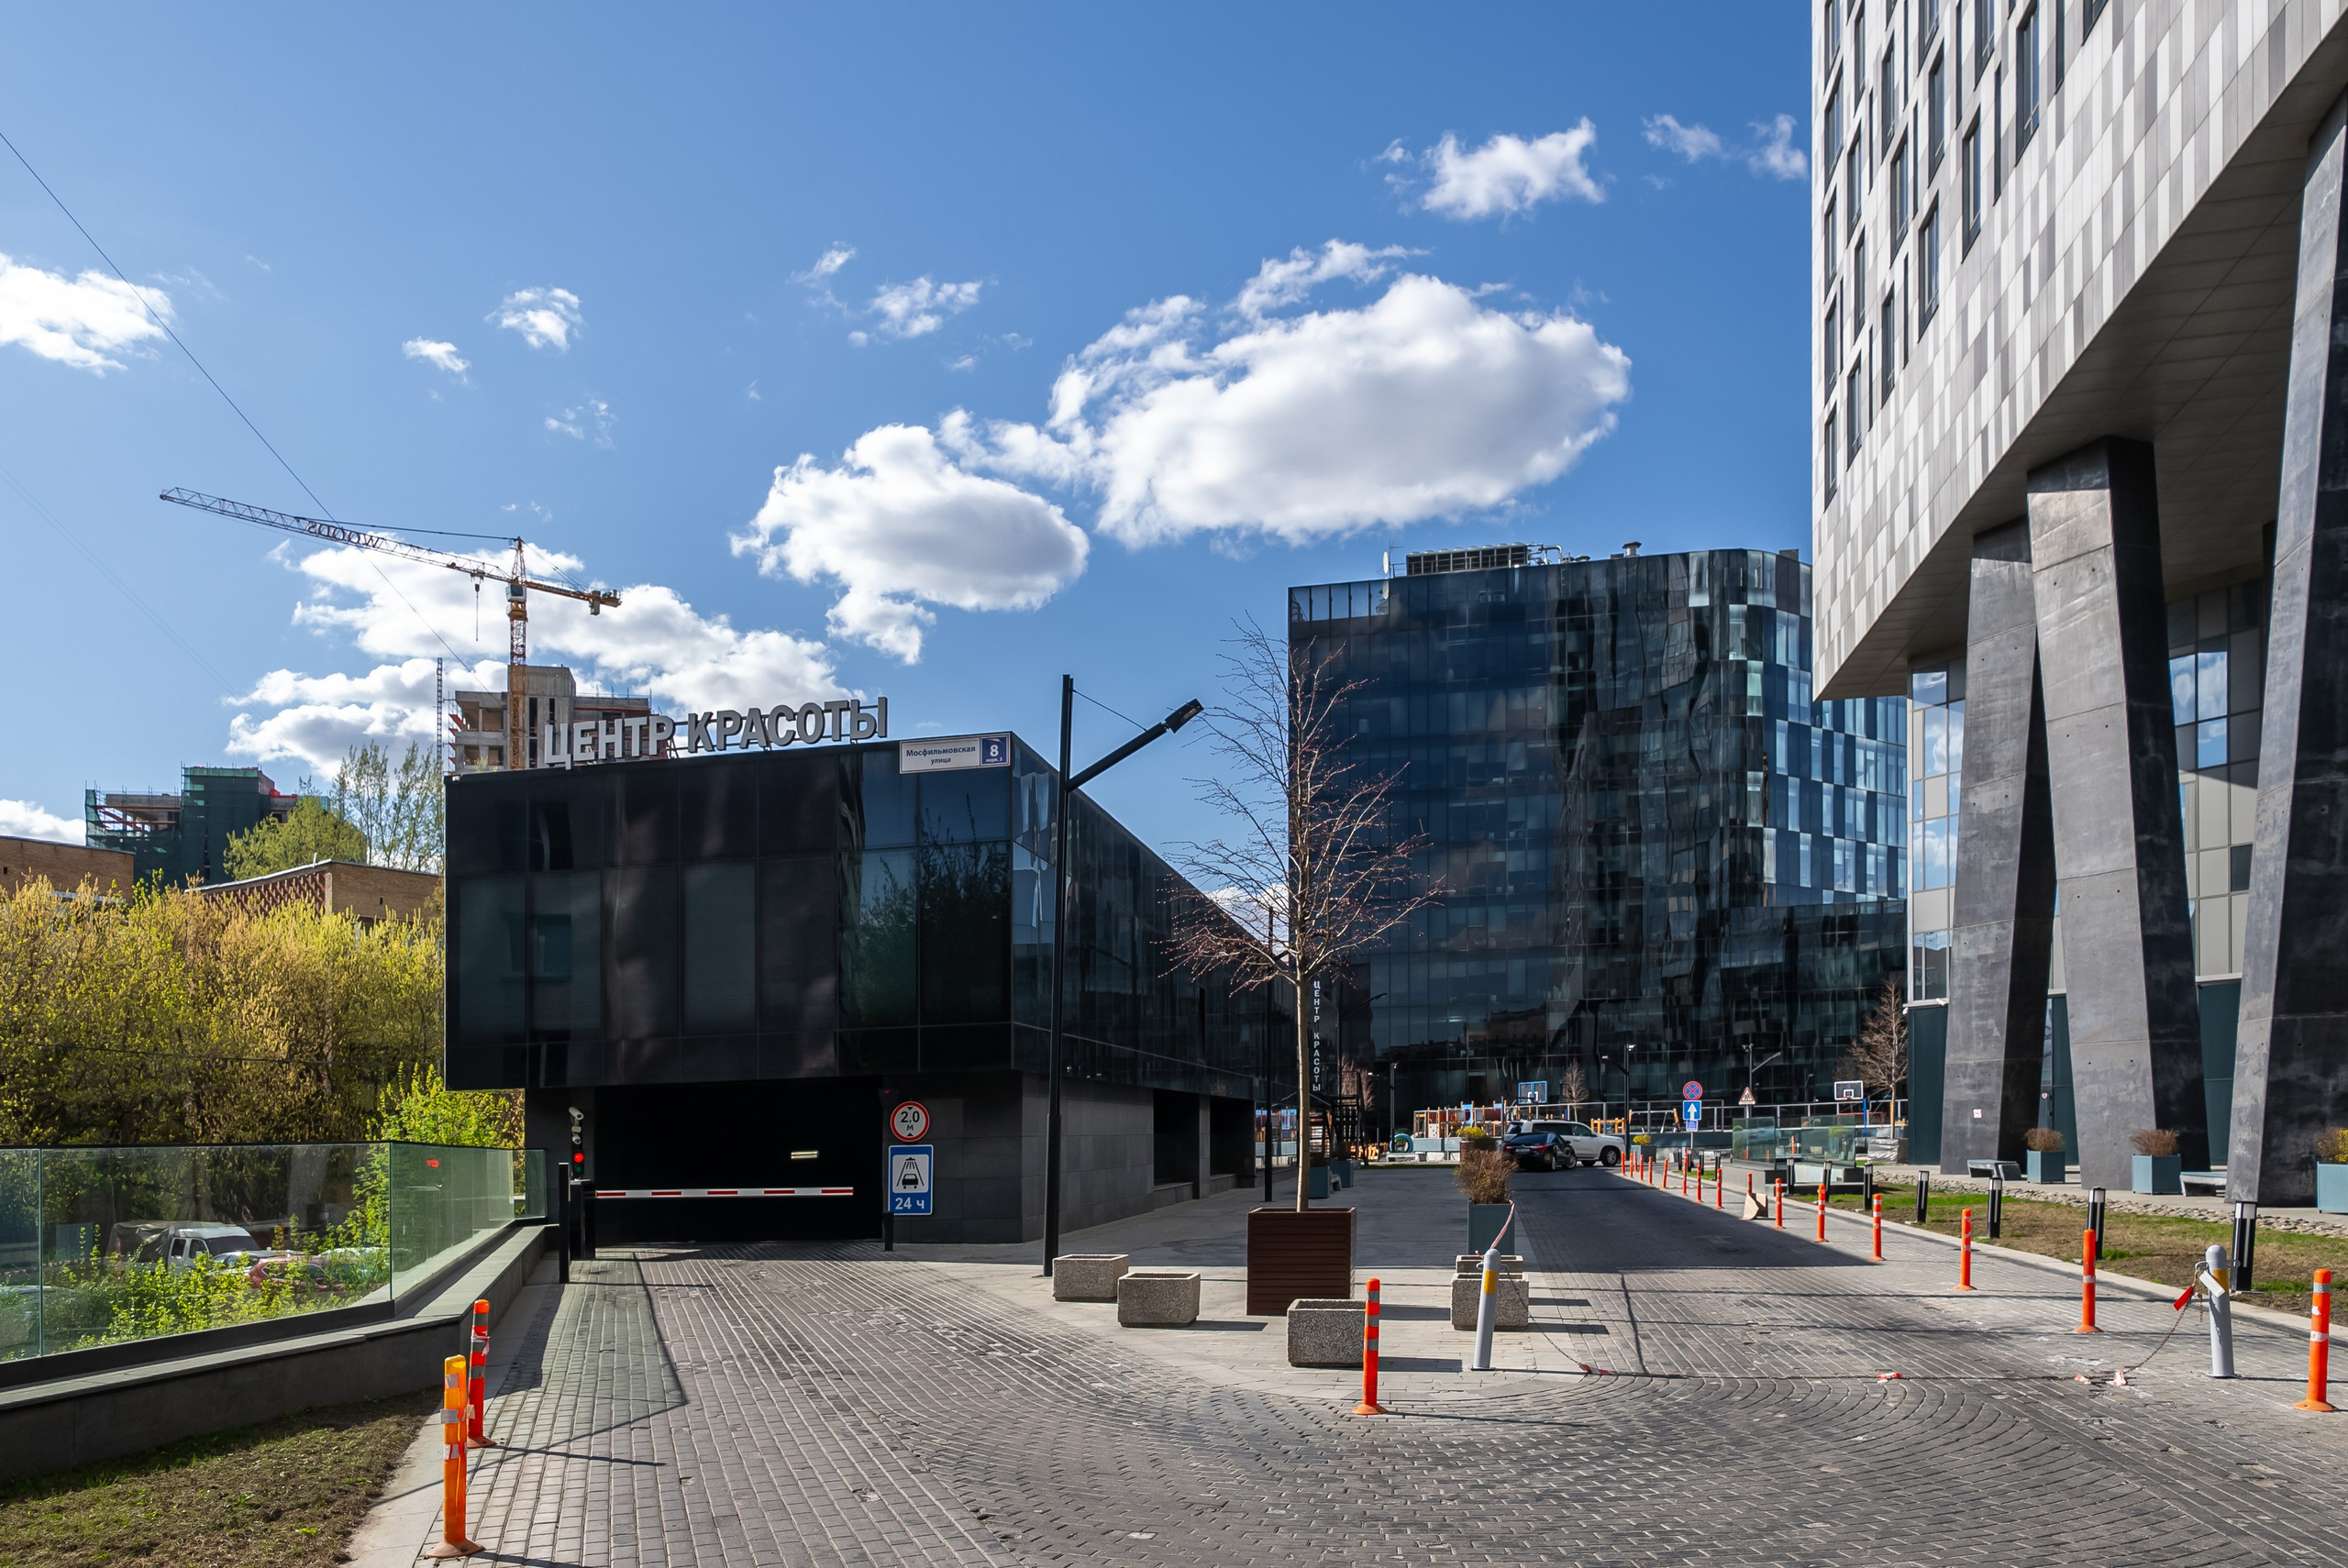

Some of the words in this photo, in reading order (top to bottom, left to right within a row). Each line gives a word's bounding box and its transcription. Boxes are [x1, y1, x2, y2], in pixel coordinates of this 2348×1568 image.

[544, 715, 677, 770] ЦЕНТР
[688, 696, 888, 754] КРАСОТЫ
[906, 745, 976, 757] Мосфильмовская
[990, 744, 999, 757] 8
[930, 756, 952, 766] улица
[1312, 1032, 1321, 1092] КРАСОТЫ
[900, 1110, 920, 1124] 2,0
[895, 1197, 912, 1210] 24
